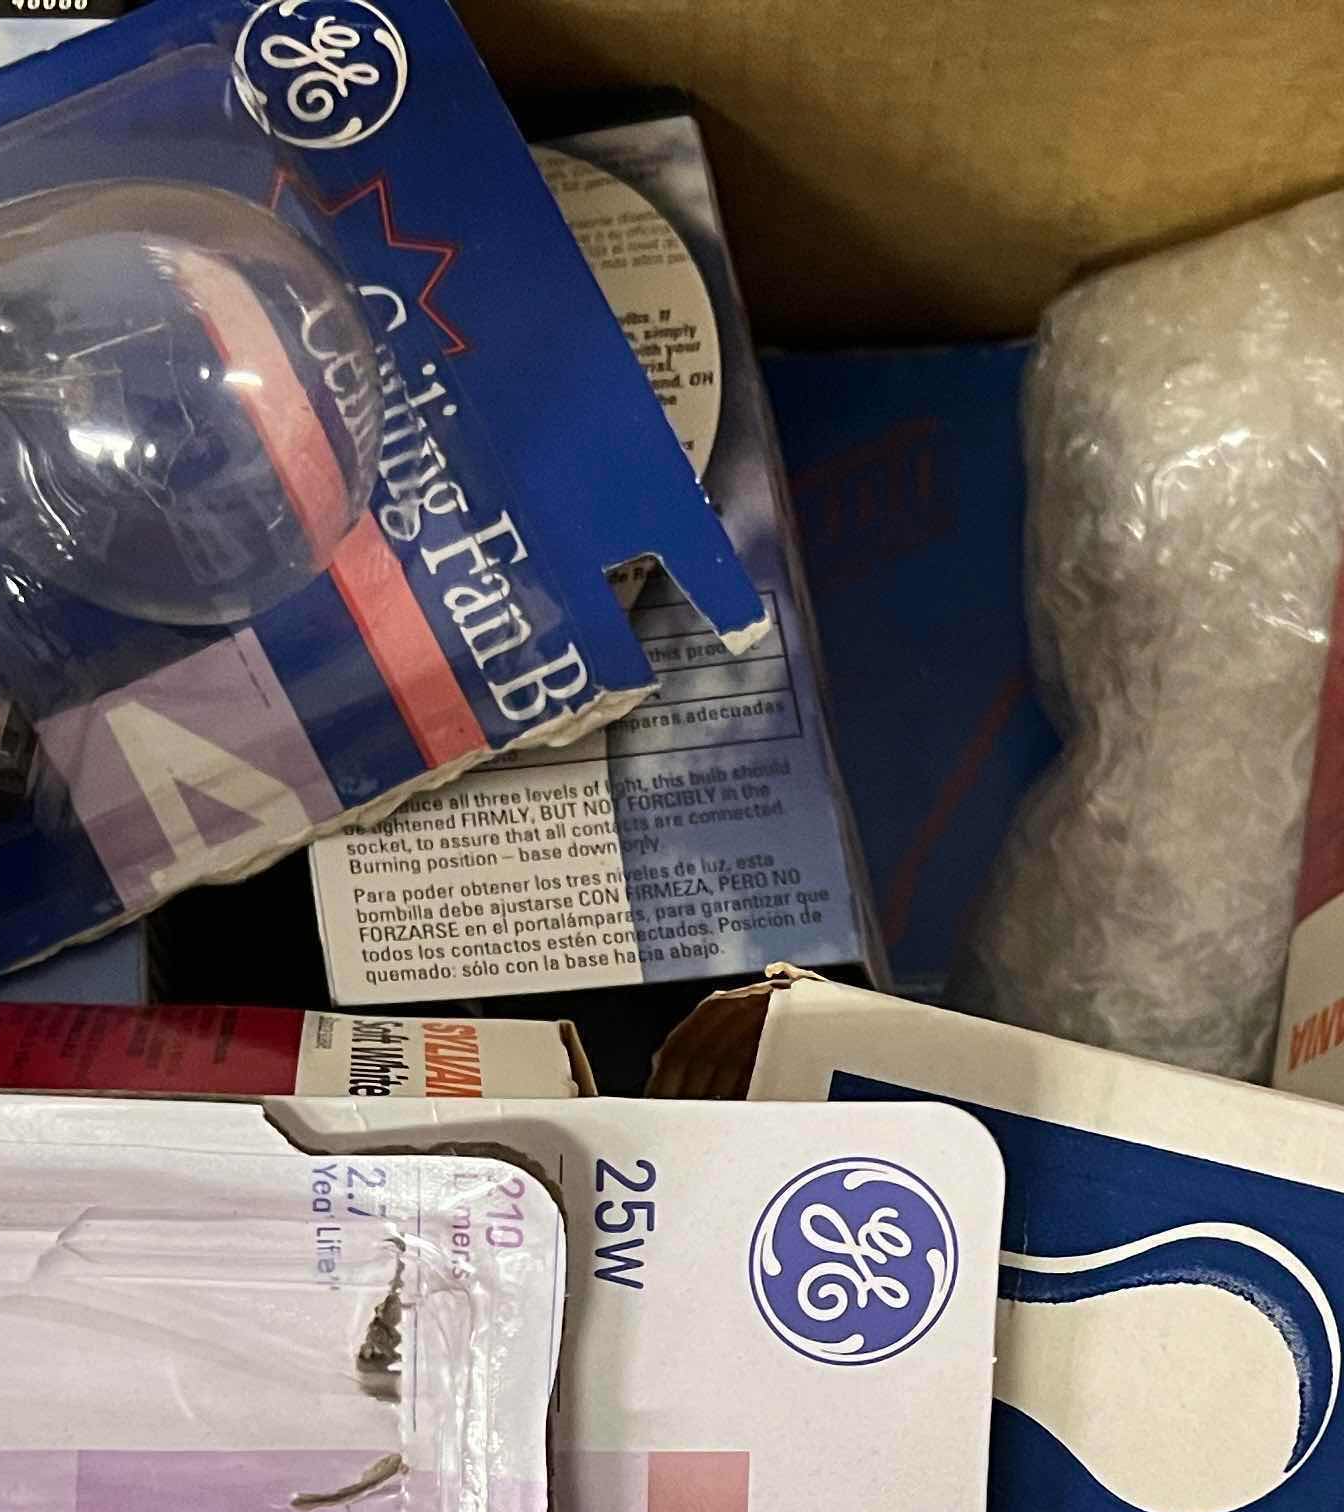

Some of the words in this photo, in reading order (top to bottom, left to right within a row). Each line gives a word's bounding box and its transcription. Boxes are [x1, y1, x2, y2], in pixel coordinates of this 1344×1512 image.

[420, 511, 533, 671] Fan
[488, 641, 588, 722] B
[450, 793, 469, 810] all
[473, 789, 521, 808] three
[525, 783, 577, 803] levels
[583, 780, 600, 797] of
[461, 806, 536, 830] FIRMLY,
[540, 802, 578, 820] BUT
[346, 836, 411, 858] socket,
[416, 836, 433, 851] to
[439, 832, 499, 850] assure
[505, 826, 539, 843] that
[545, 823, 565, 840] all
[349, 854, 421, 879] Burning
[426, 851, 497, 876] position
[518, 844, 561, 862] base
[567, 839, 617, 858] down
[353, 885, 395, 905] Para
[402, 881, 453, 904] poder
[460, 875, 530, 898] obtener
[534, 872, 561, 890] los
[566, 871, 601, 887] tres
[674, 860, 696, 877] de
[357, 902, 433, 925] bombilla
[438, 900, 483, 919] debe
[489, 892, 573, 917] ajustarse
[578, 887, 619, 907] CON
[718, 872, 768, 892] PERO
[772, 869, 801, 886] NO
[359, 919, 459, 947] FORZARSE
[464, 924, 487, 936] en
[492, 919, 508, 935] el
[655, 904, 695, 921] para
[700, 891, 791, 917] garantizar
[796, 888, 830, 911] que
[361, 943, 413, 964] todos
[418, 942, 445, 960] los
[450, 936, 541, 959] contactos
[547, 930, 597, 950] estén
[800, 908, 822, 925] de
[366, 962, 457, 990] quemado:
[461, 958, 499, 978] sólo
[505, 958, 538, 974] con
[543, 954, 559, 970] la
[565, 949, 609, 969] base
[669, 939, 725, 962] abajo.
[351, 1020, 408, 1043] Soft
[348, 1047, 408, 1096] White
[484, 1171, 526, 1251] 210
